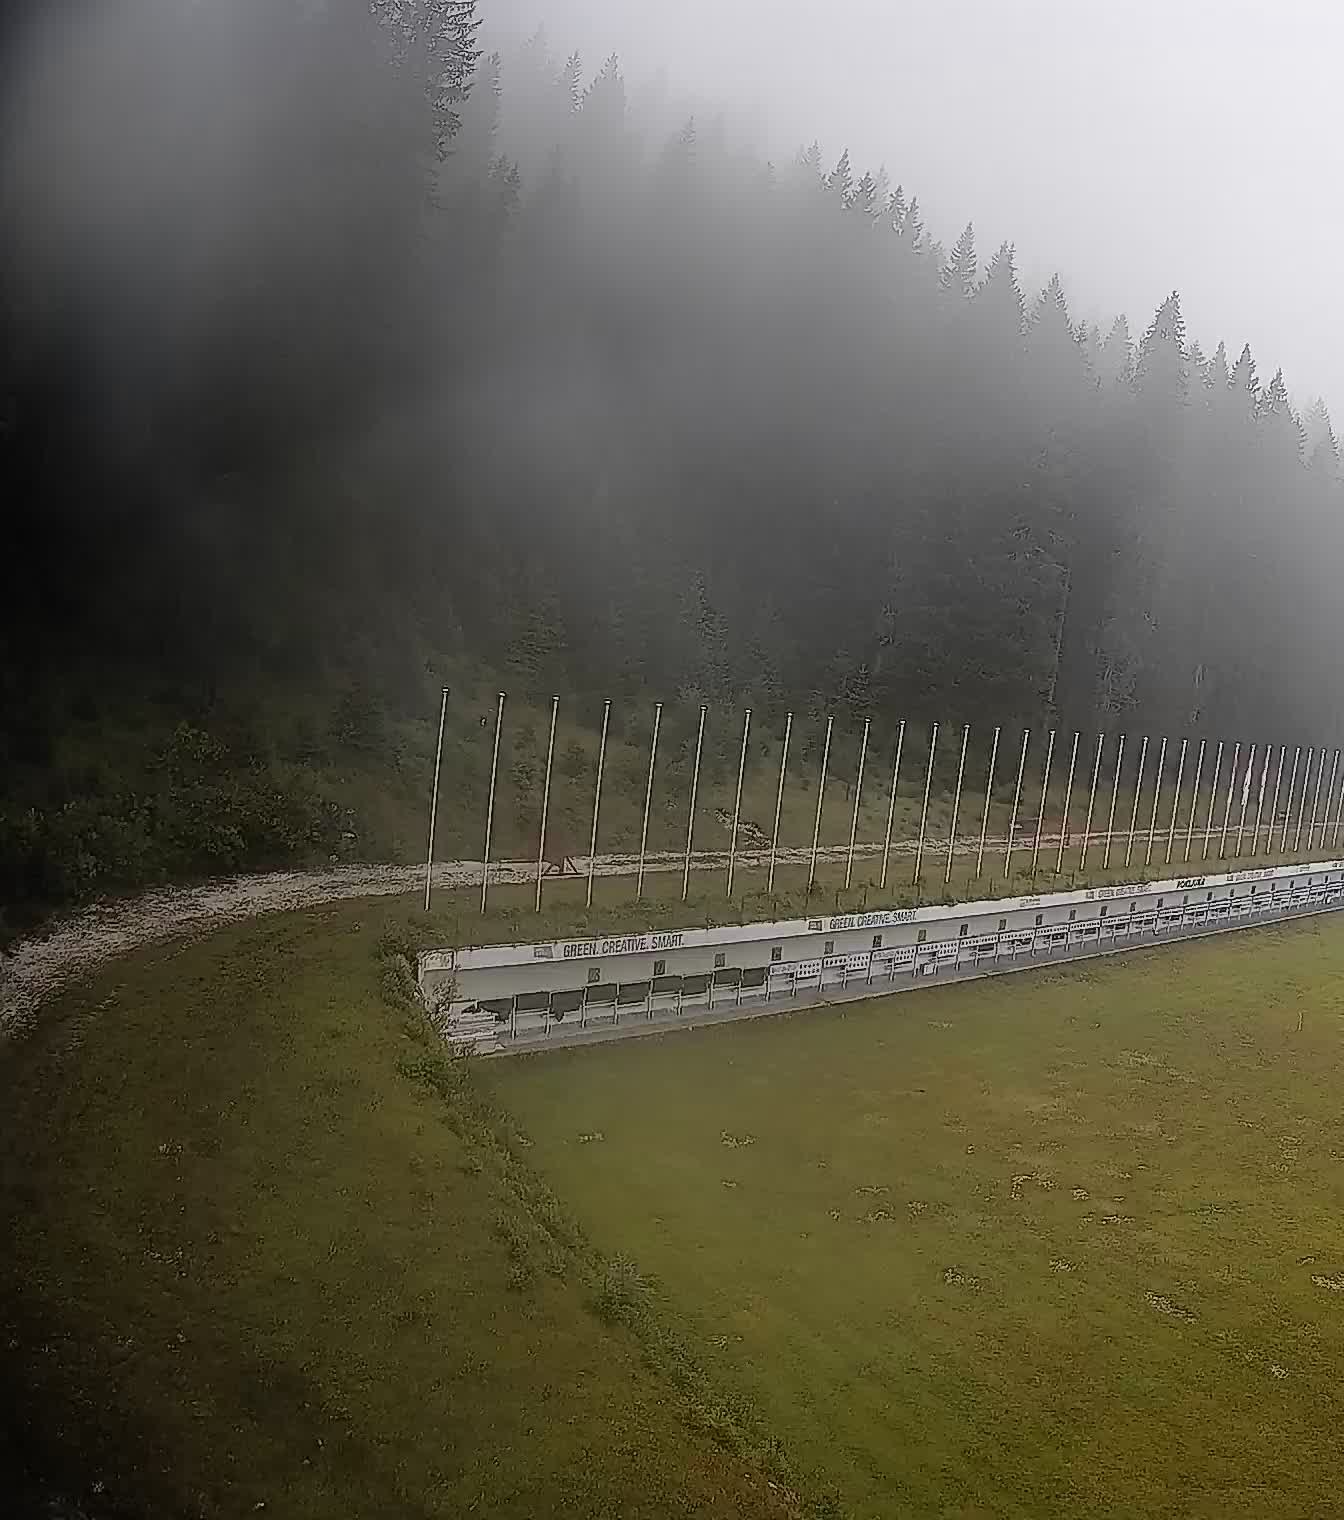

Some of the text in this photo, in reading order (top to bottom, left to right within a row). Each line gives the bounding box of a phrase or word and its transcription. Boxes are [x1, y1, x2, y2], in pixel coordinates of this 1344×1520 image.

[563, 944, 599, 958] GREEN.
[602, 938, 649, 954] CREATIVE.
[652, 933, 685, 949] SMART.
